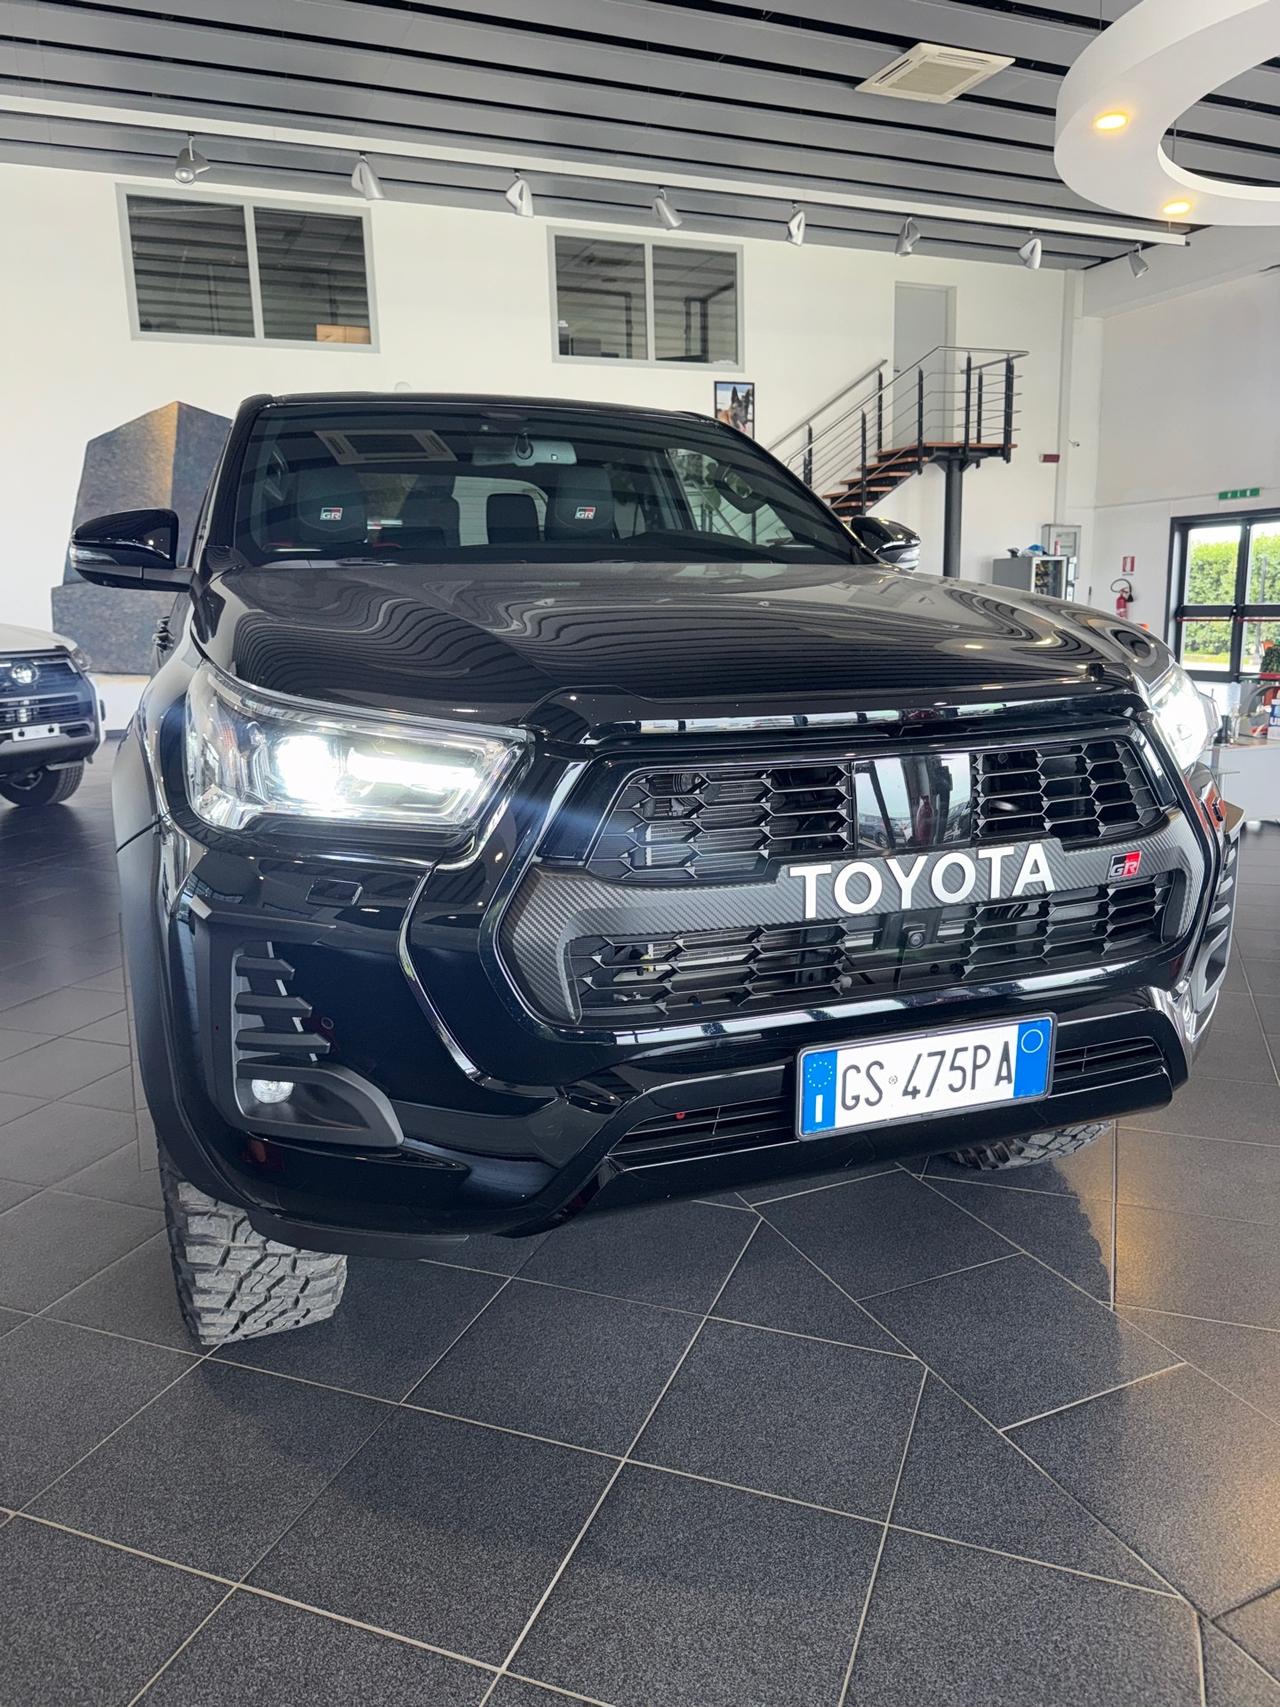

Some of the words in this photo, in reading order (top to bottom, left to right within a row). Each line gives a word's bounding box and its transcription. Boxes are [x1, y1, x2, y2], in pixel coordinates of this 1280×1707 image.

[789, 843, 1056, 919] TOYOTA
[1110, 861, 1138, 877] GR
[841, 1060, 884, 1111] GS
[902, 1040, 1013, 1100] 475PA
